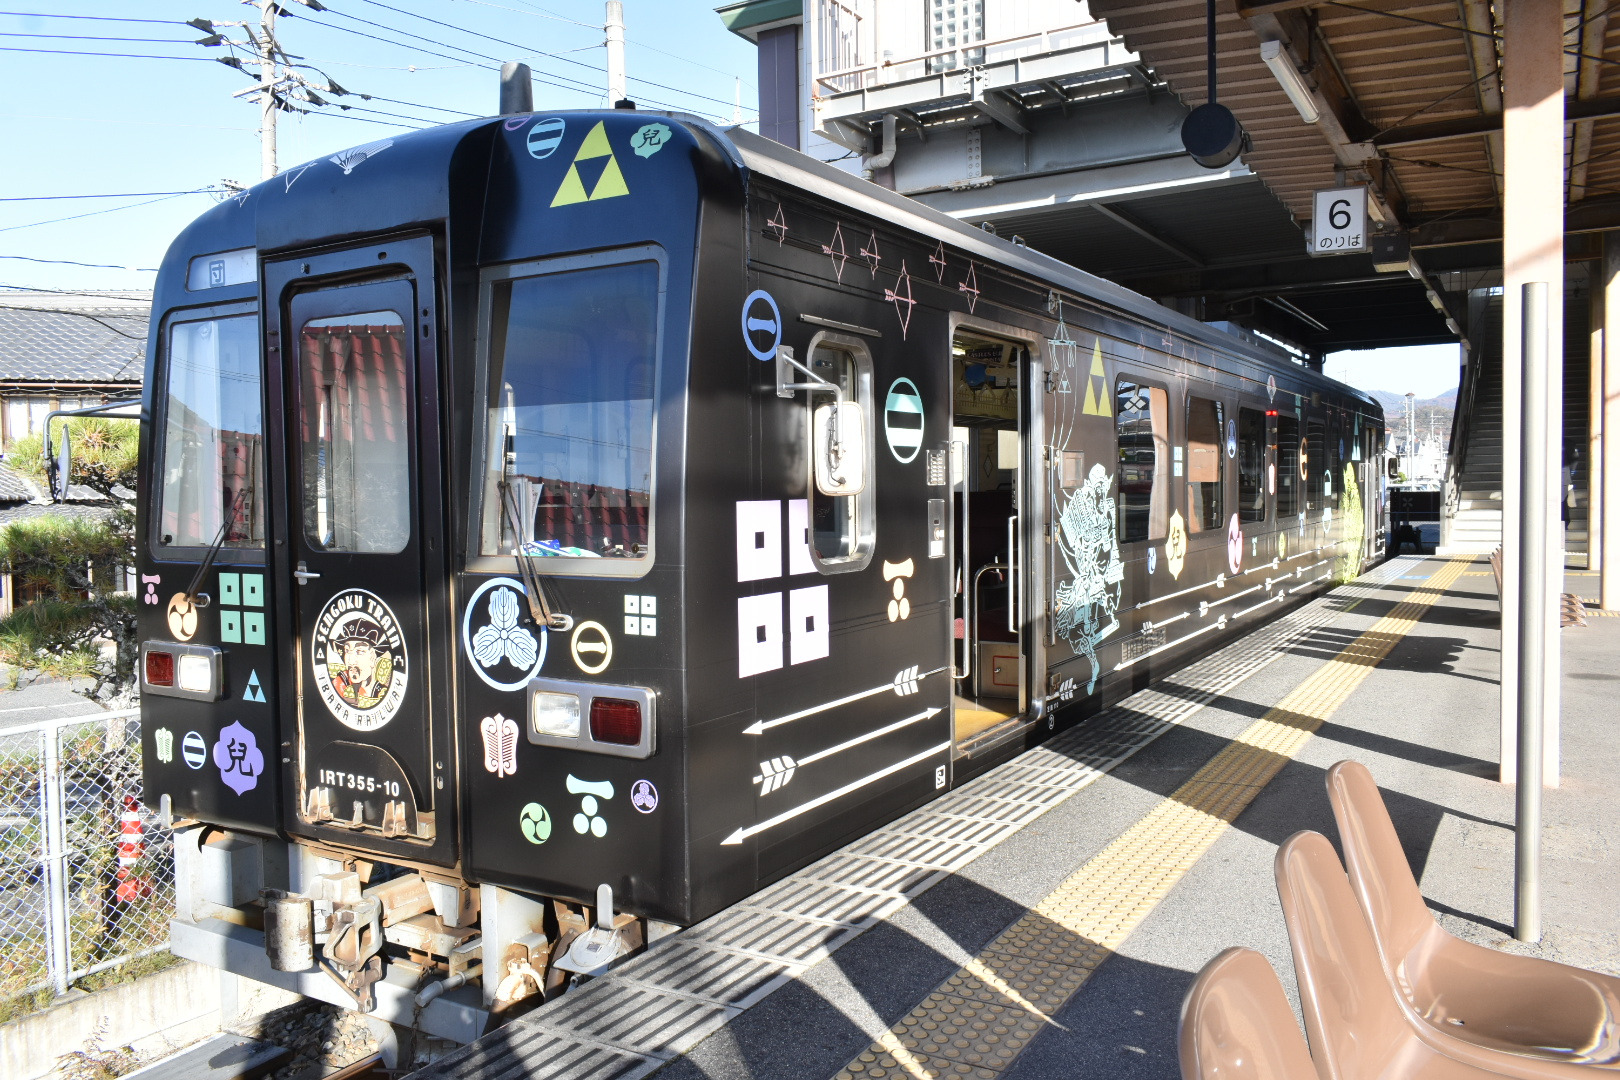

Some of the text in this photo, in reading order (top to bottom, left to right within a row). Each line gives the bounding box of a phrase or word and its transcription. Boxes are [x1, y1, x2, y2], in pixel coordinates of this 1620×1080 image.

[1329, 199, 1351, 230] 6
[1320, 233, 1361, 249] のりば
[317, 595, 401, 650] SENGOKU TRAIN
[318, 676, 404, 727] IBARA RAILWAY
[319, 768, 400, 797] IRT355-10
